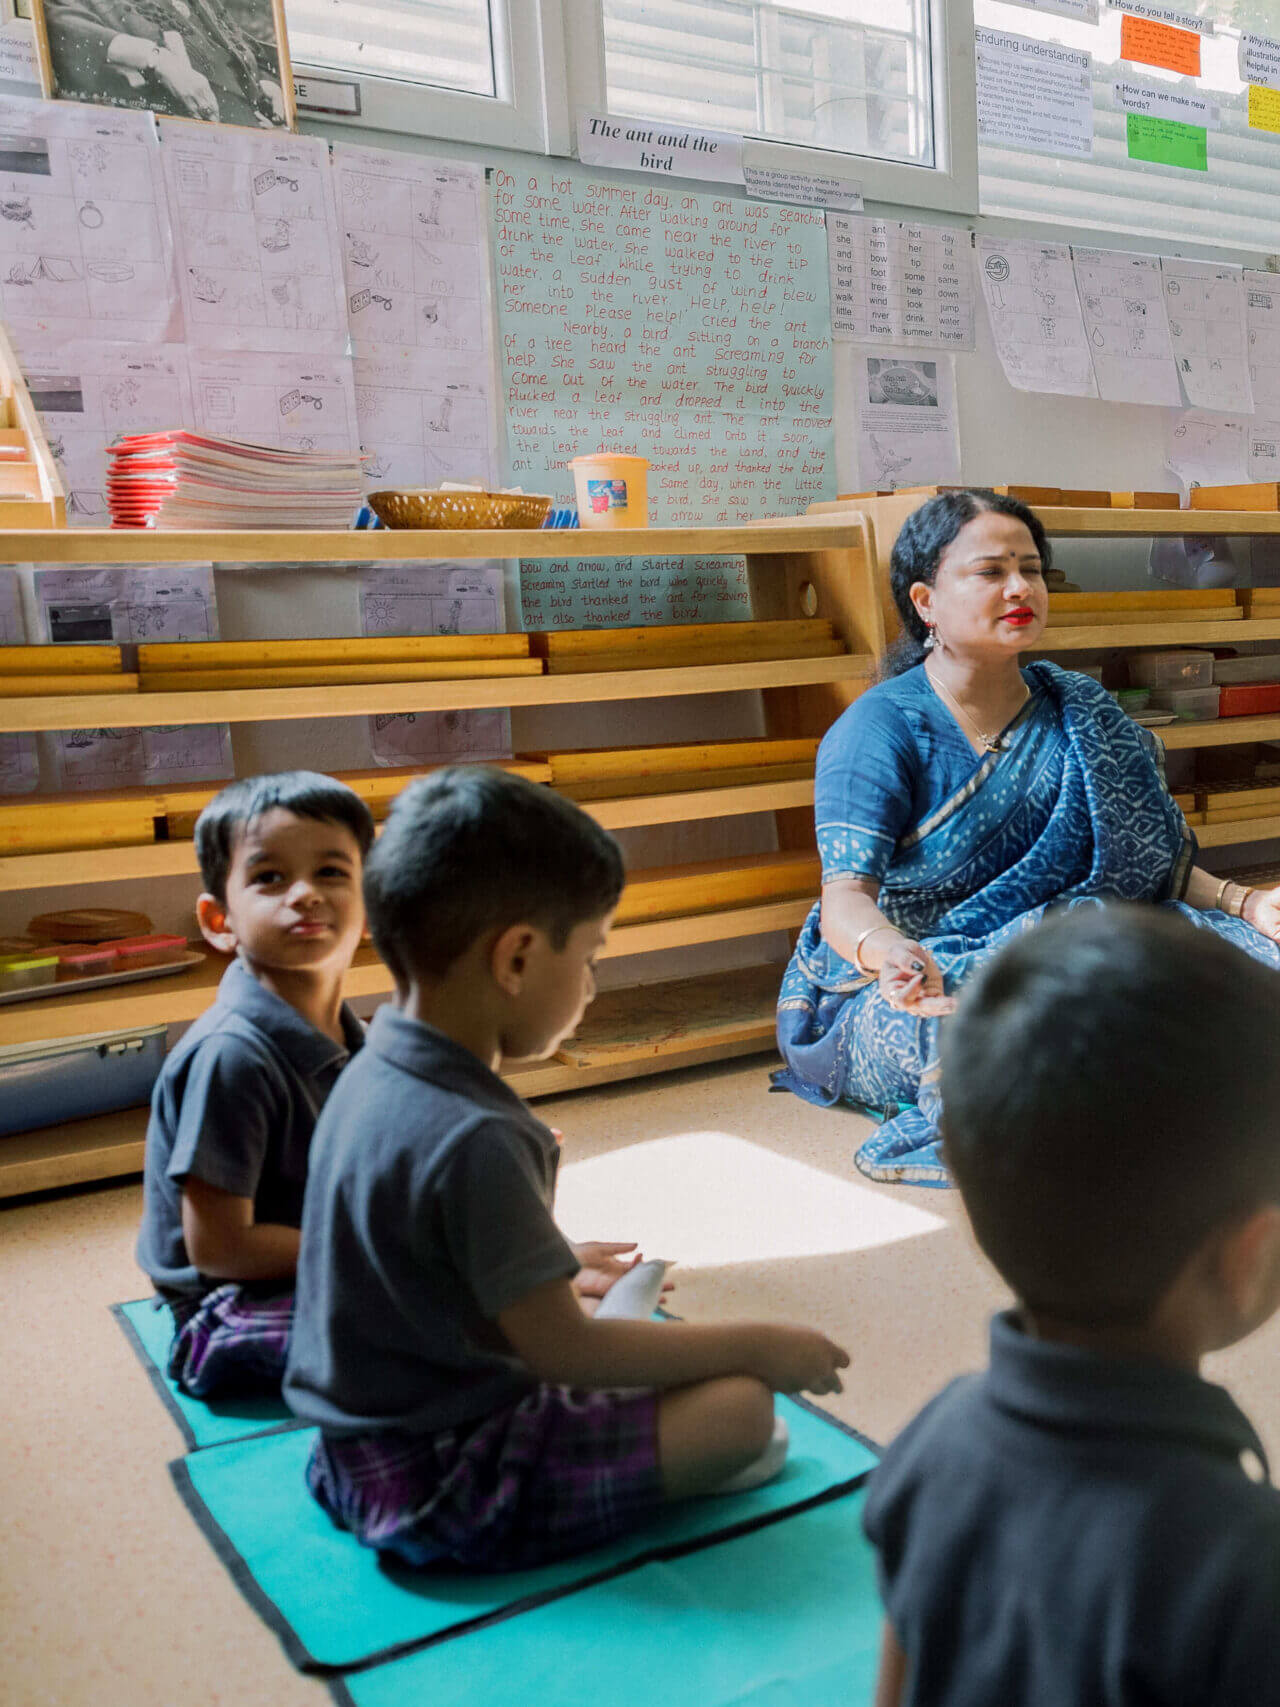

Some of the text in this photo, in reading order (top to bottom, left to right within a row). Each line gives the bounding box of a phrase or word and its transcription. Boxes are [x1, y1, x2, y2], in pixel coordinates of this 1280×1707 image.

[1115, 1, 1133, 10] How
[1135, 5, 1145, 14] do
[1147, 9, 1162, 17] you
[1164, 11, 1175, 20] tell
[1182, 17, 1203, 29] story?
[975, 30, 1088, 68] Enduring understanding
[1249, 35, 1280, 50] Why/How
[1246, 60, 1270, 73] helpful
[1271, 66, 1277, 75] in
[1247, 74, 1268, 85] story?
[1122, 99, 1150, 110] words?
[1123, 84, 1206, 110] How can we make new
[589, 118, 718, 154] The ant and the
[640, 153, 673, 171] bird
[746, 168, 758, 176] This
[496, 170, 770, 219] On a hot summer an ant was
[494, 189, 758, 234] for some around
[495, 208, 803, 255] some she came near the river to
[836, 220, 955, 244] the ant hot day
[498, 225, 775, 269] drink the walked to the
[837, 235, 851, 244] she
[870, 239, 886, 249] him
[908, 244, 922, 253] her
[837, 249, 955, 271] and bow tip out
[837, 264, 852, 274] bird
[905, 273, 926, 282] some
[938, 277, 959, 285] same
[552, 269, 817, 302] a sudden gust wind blew
[837, 278, 960, 299] leaf tree help down
[836, 293, 960, 314] walk wind look jump
[703, 315, 737, 328] cried
[836, 307, 960, 327] little river drink water
[834, 321, 964, 340] climb thank summer hunter
[544, 336, 817, 365] tree heard the ant for
[793, 334, 830, 350] branch
[589, 358, 616, 370] saw
[667, 363, 688, 375] ant
[706, 364, 769, 381] struggling
[783, 367, 797, 380] to
[661, 380, 825, 400] water The bird quickly
[760, 398, 821, 414] into the
[509, 406, 834, 429] river near The moved
[735, 460, 772, 473] thanked
[640, 576, 728, 589] bird quickly
[550, 594, 629, 608] bird thanked
[552, 609, 664, 625] also thanked the
